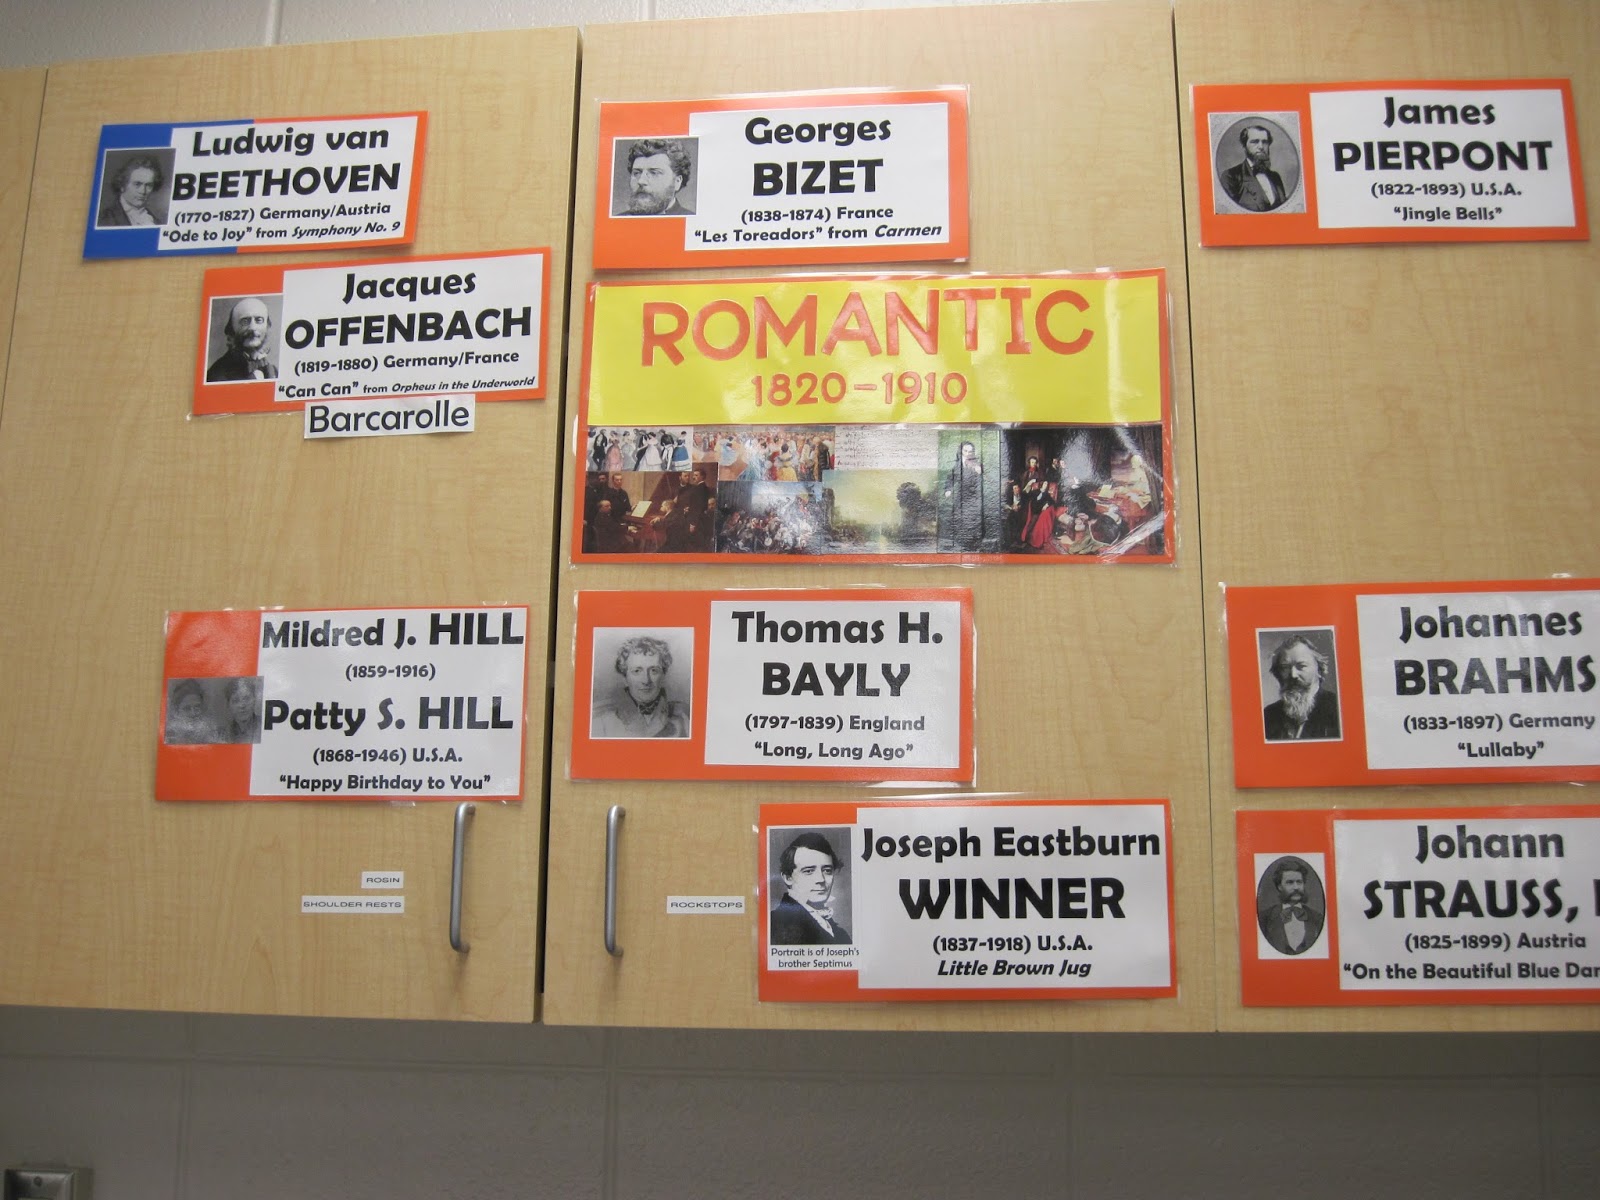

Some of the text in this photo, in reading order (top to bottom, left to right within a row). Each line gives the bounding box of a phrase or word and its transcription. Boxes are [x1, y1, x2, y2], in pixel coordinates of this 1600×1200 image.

[1382, 96, 1496, 129] James
[191, 126, 389, 158] Ludwig van
[744, 116, 892, 147] Georges
[1332, 140, 1553, 172] PIERPONT
[172, 162, 401, 201] BEETHOVEN
[752, 158, 883, 197] BIZET
[1370, 182, 1522, 199] (1822-1893) U.S.A.
[174, 202, 391, 226] (1770-1827) Germany/Austria
[740, 205, 894, 226] (1838-1874) France
[1393, 205, 1503, 223] “Jingle Bells”
[162, 220, 401, 244] “Ode to Joy” from Symphony No. 9
[694, 223, 942, 244] “Les Toreadors” from Carmen
[342, 272, 477, 305] Jacques
[284, 306, 531, 350] OFFENBACH
[641, 286, 1096, 368] ROMANTIC
[294, 350, 519, 376] (1819-1880) Germany/France
[278, 376, 535, 399] “Can Can” from Orpheus in the Underworld
[308, 399, 470, 434] Barcarolle
[262, 612, 524, 650] Mildred J. HILL
[731, 610, 944, 645] Thomas H.
[1399, 605, 1582, 644] Johannes
[345, 663, 437, 681] (1859-1916)
[761, 661, 911, 697] BAYLY
[1394, 655, 1596, 696] BRAHMS
[263, 695, 514, 737] Patty S. HILL
[744, 713, 925, 734] (1797-1839) England
[1403, 712, 1596, 734] (1833-1897) Germany
[312, 747, 463, 765] (1868-1946) U.S.A.
[754, 741, 914, 761] “Long, Long Ago”
[1457, 740, 1545, 760] “Lullaby”
[279, 774, 491, 793] “Happy Birthday to You”
[860, 826, 1160, 862] Joseph Eastburn
[1415, 824, 1564, 864] Johann
[366, 876, 400, 884] ROSIN
[303, 900, 402, 909] SHOULDER RESTS
[670, 901, 743, 909] ROCKSTOPS
[898, 876, 1126, 920] WINNER
[1363, 878, 1580, 924] STRAUSS,
[771, 946, 860, 959] Portrait is of Joseph's
[932, 934, 1093, 955] (1837-1918) U.S.A.
[1404, 932, 1587, 953] (1825-1899) Austria
[778, 958, 852, 970] brother Septimus
[936, 958, 1092, 978] Little Brown Jug
[1343, 963, 1381, 980] “On
[1385, 963, 1417, 980] the
[1423, 962, 1512, 980] Beautiful
[1517, 962, 1560, 979] Blue
